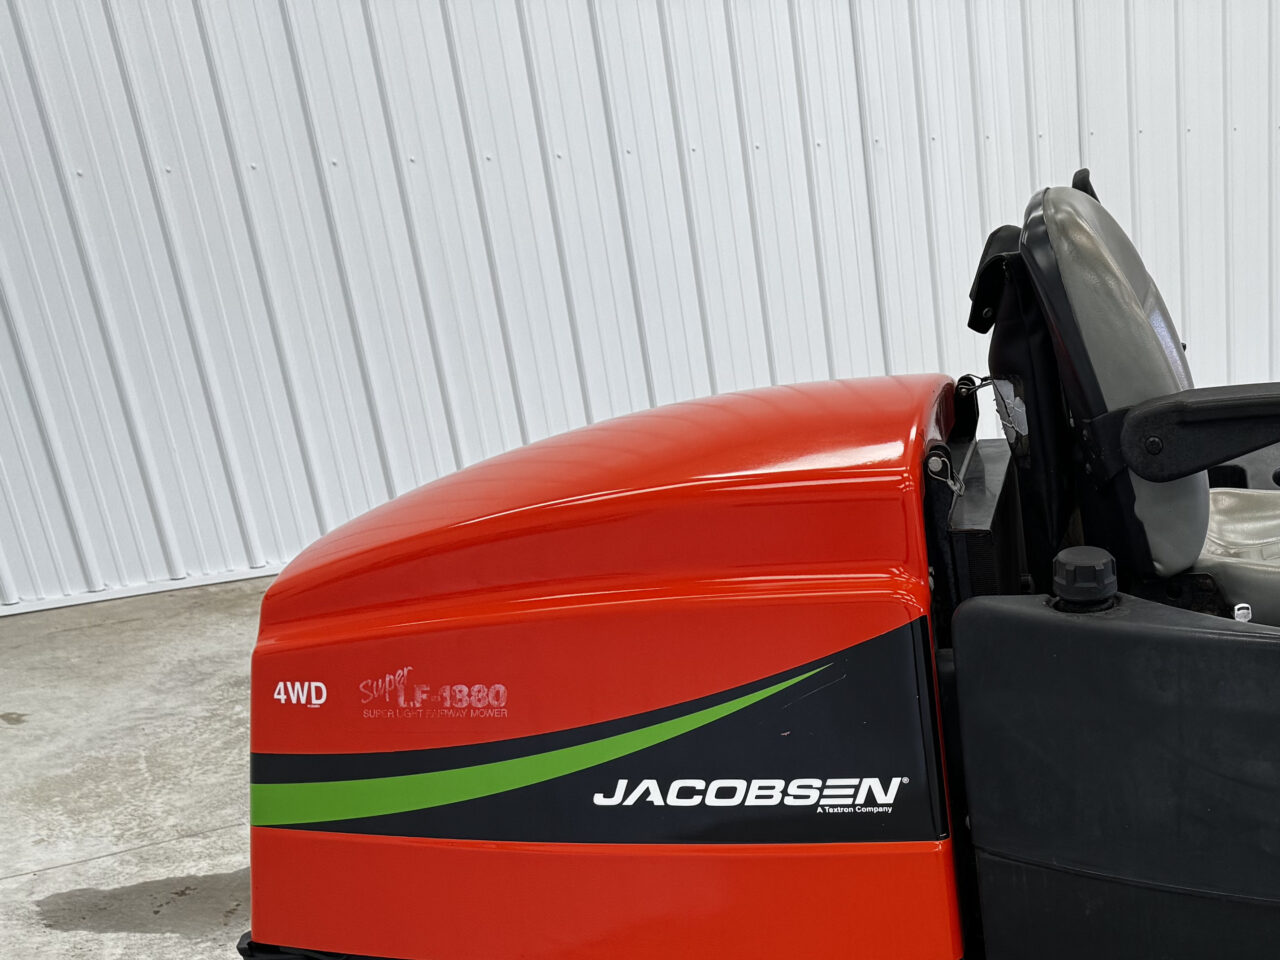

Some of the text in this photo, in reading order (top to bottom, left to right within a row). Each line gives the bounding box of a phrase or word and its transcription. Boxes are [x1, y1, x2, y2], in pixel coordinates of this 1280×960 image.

[273, 681, 328, 706] 4WD
[362, 709, 395, 719] SUPER
[470, 708, 508, 718] MOWER
[824, 806, 854, 814] Textron
[855, 806, 893, 815] Company
